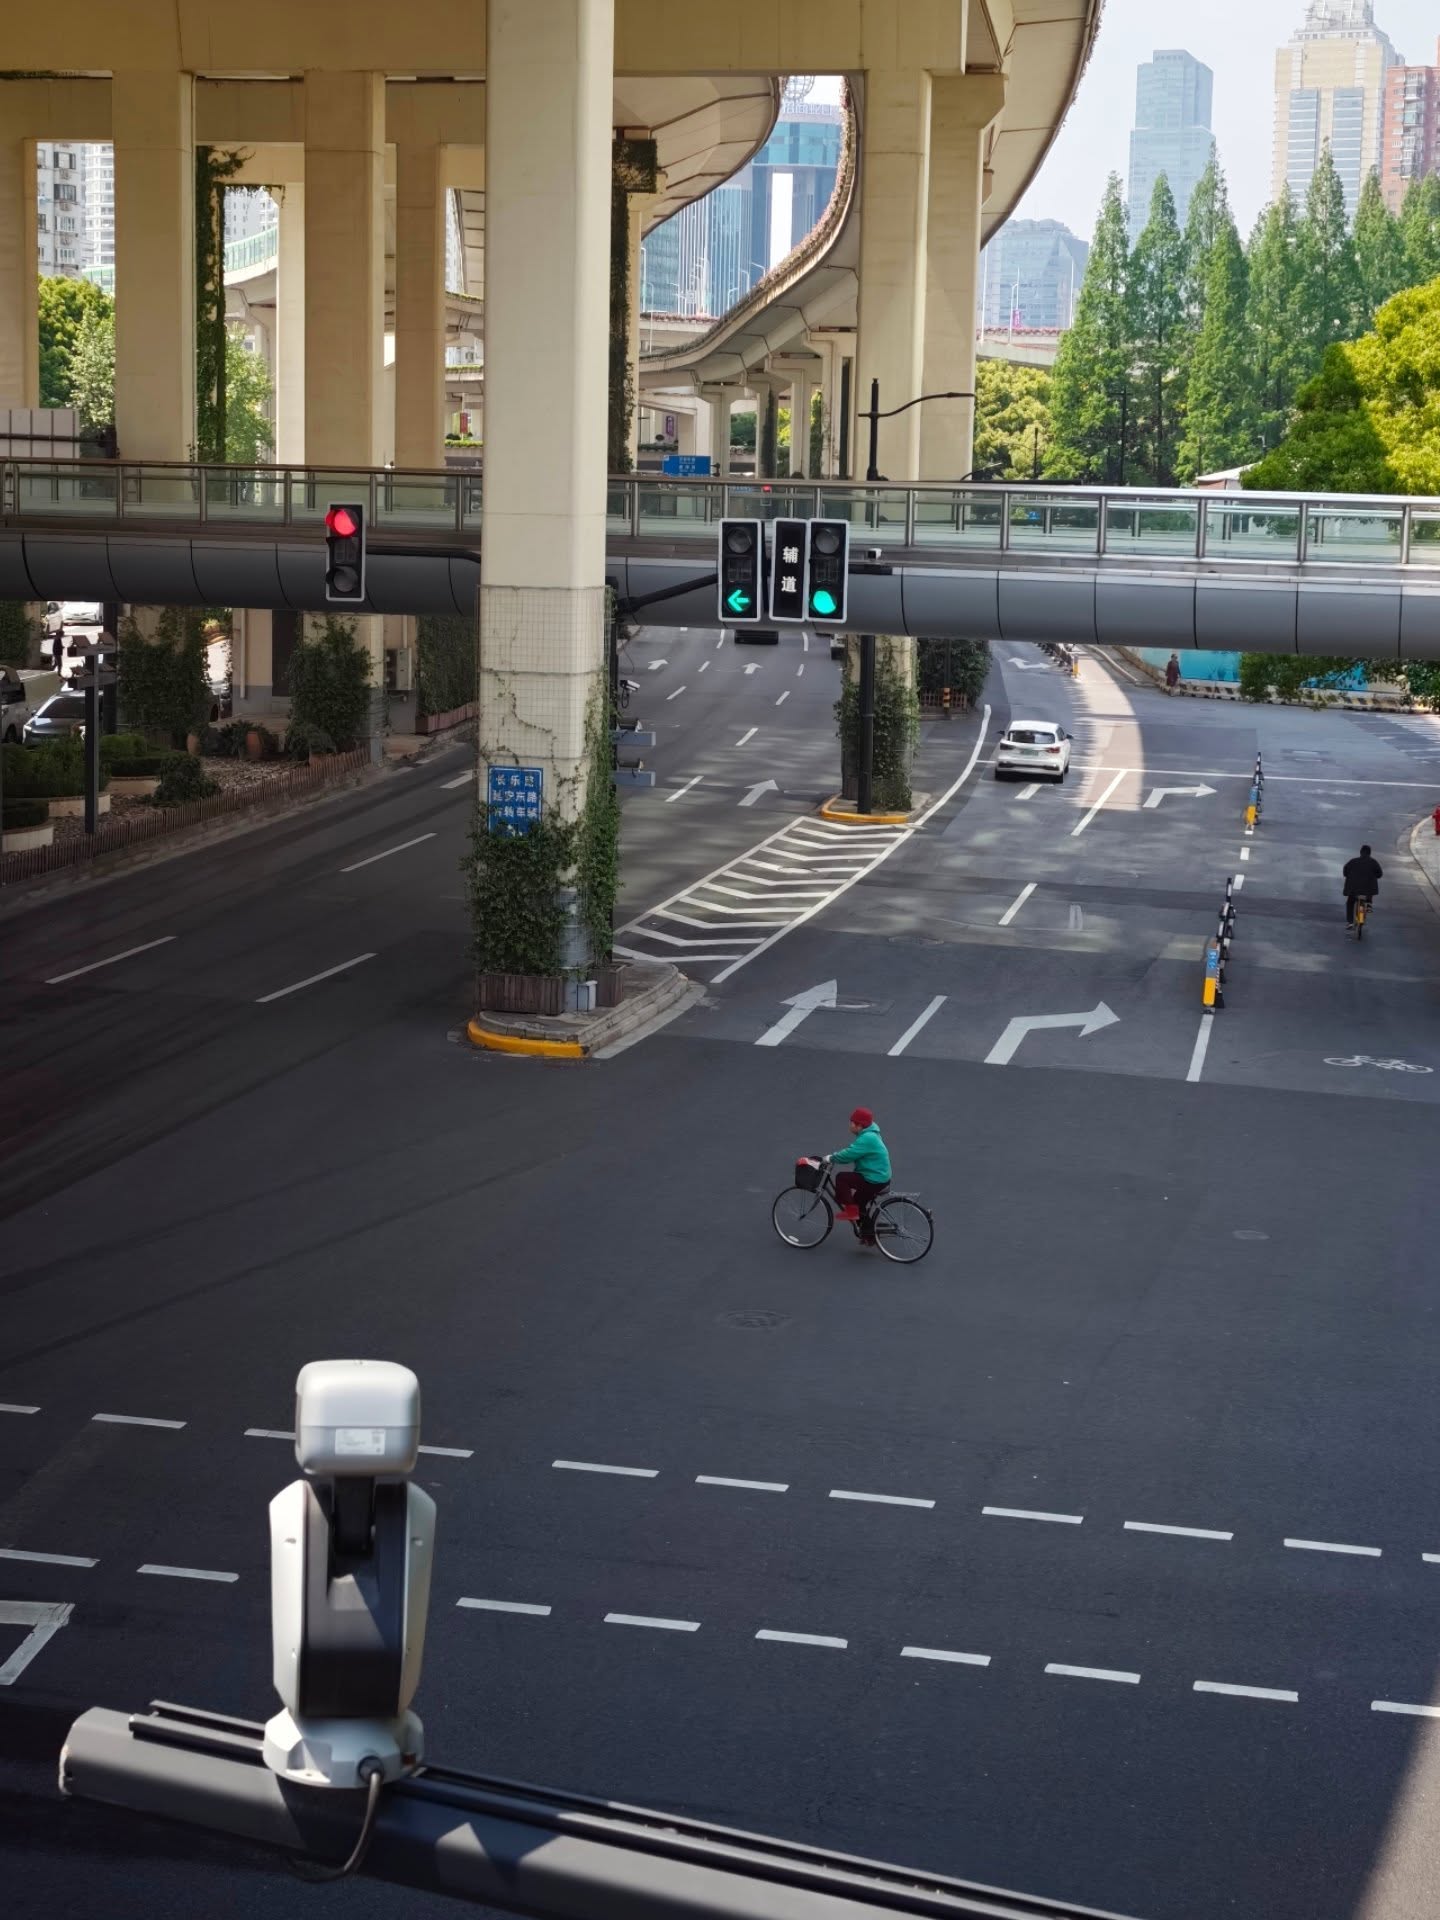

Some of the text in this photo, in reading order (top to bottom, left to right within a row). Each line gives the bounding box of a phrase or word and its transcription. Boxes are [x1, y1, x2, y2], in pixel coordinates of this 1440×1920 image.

[781, 546, 799, 593] 辅道
[493, 790, 537, 803] 延安东路
